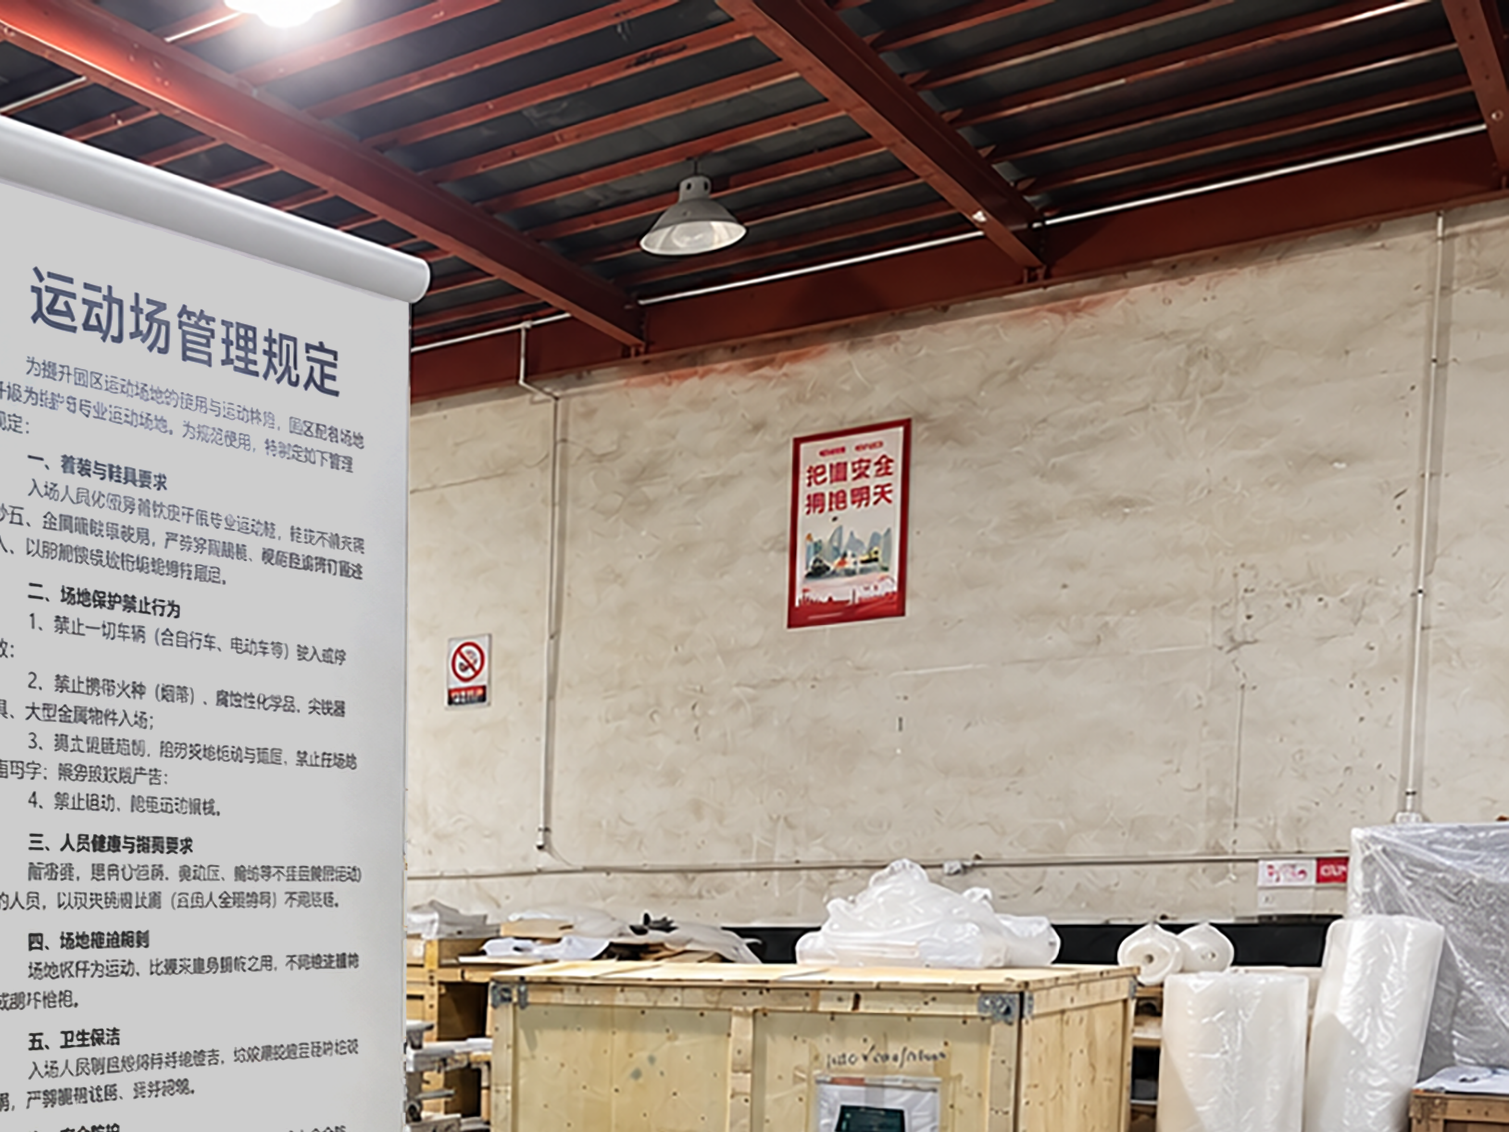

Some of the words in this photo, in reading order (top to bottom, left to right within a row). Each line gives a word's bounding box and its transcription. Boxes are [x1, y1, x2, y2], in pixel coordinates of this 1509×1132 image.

[29, 265, 341, 398] 运动场管理规定
[27, 582, 182, 619] 二、场地保护禁止行为
[27, 1026, 121, 1051] 五、卫生保洁
